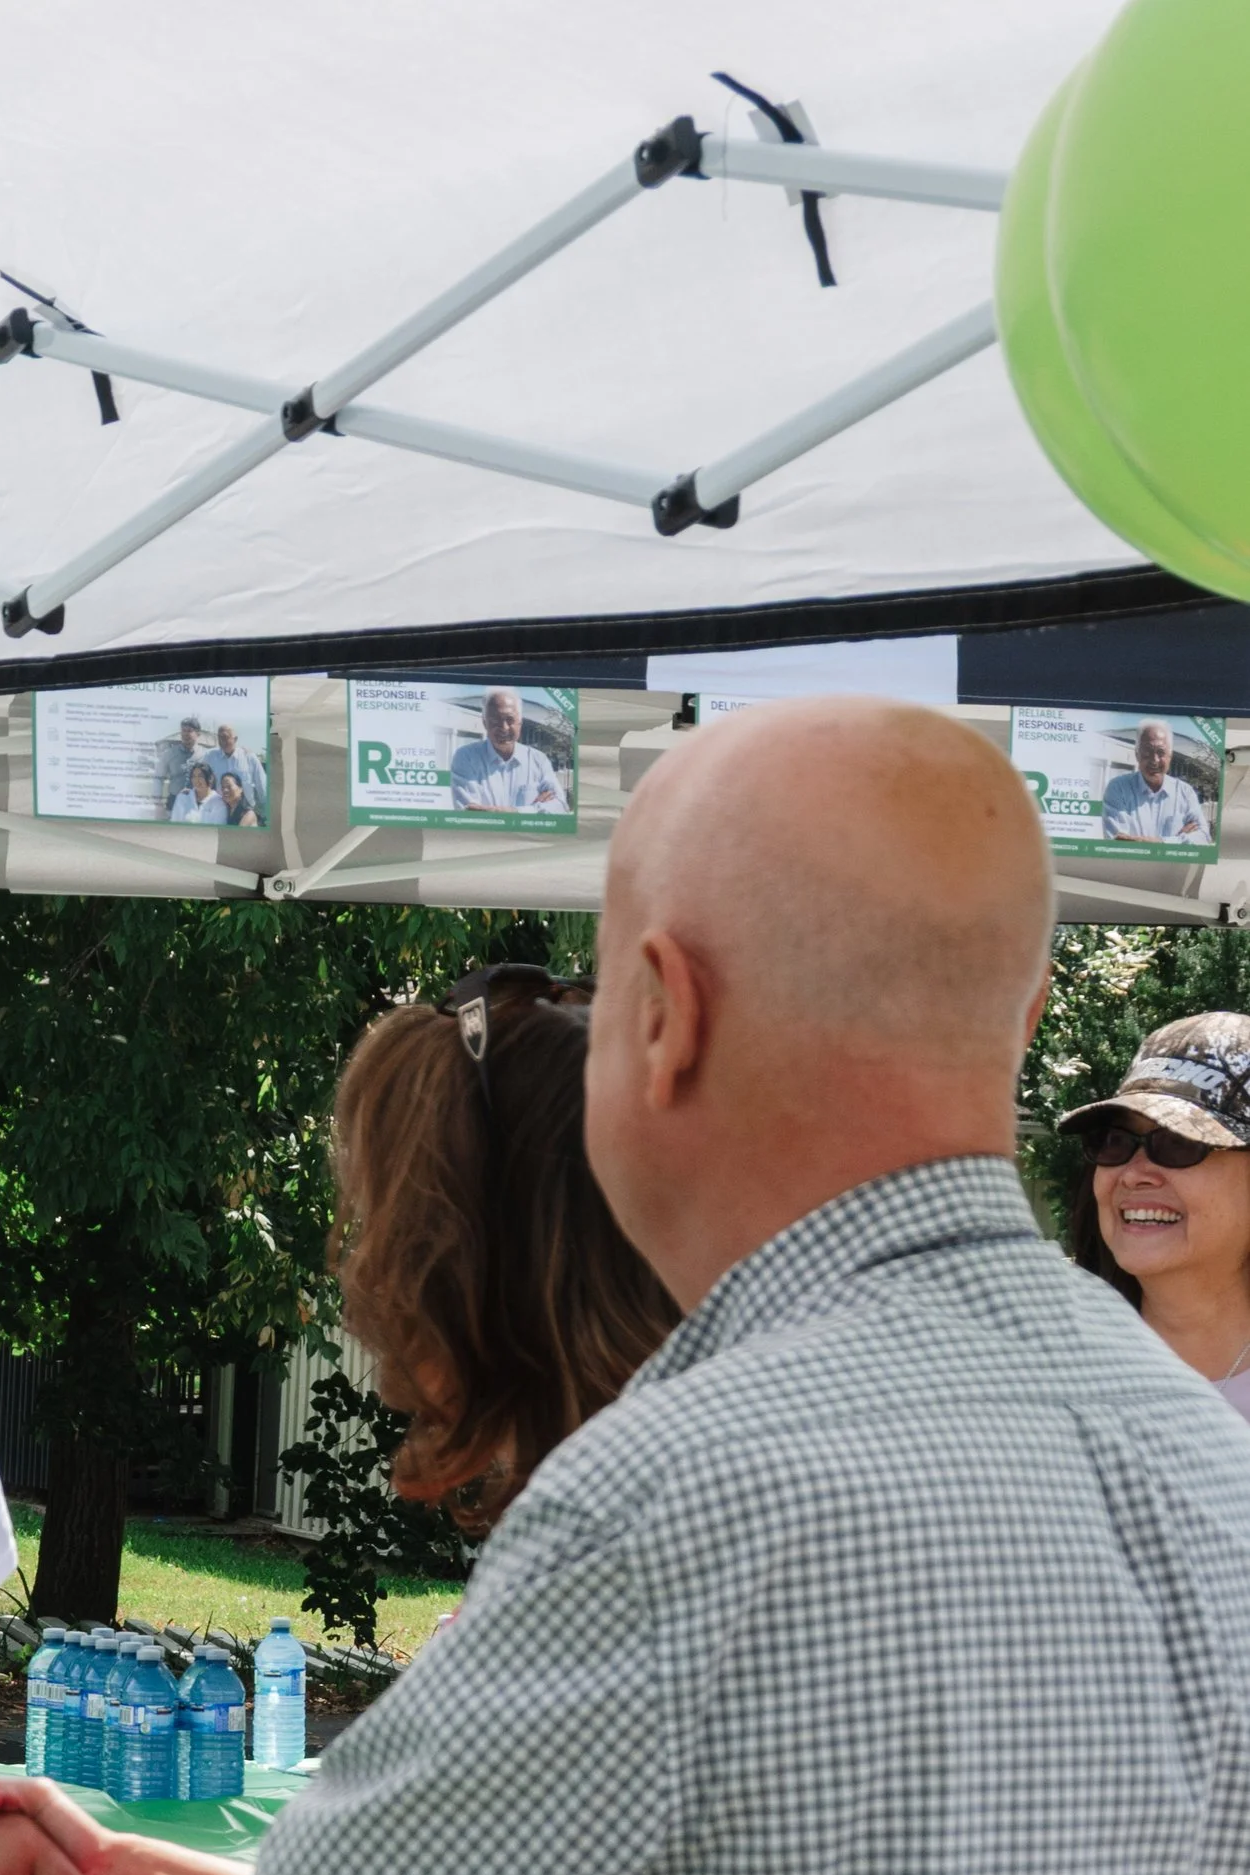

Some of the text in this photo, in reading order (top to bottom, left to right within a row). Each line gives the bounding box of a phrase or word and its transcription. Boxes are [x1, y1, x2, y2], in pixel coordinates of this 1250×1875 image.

[168, 683, 190, 694] FOR
[193, 684, 248, 697] VAUGHAN
[395, 759, 425, 769] Mario
[1051, 789, 1079, 799] Mario
